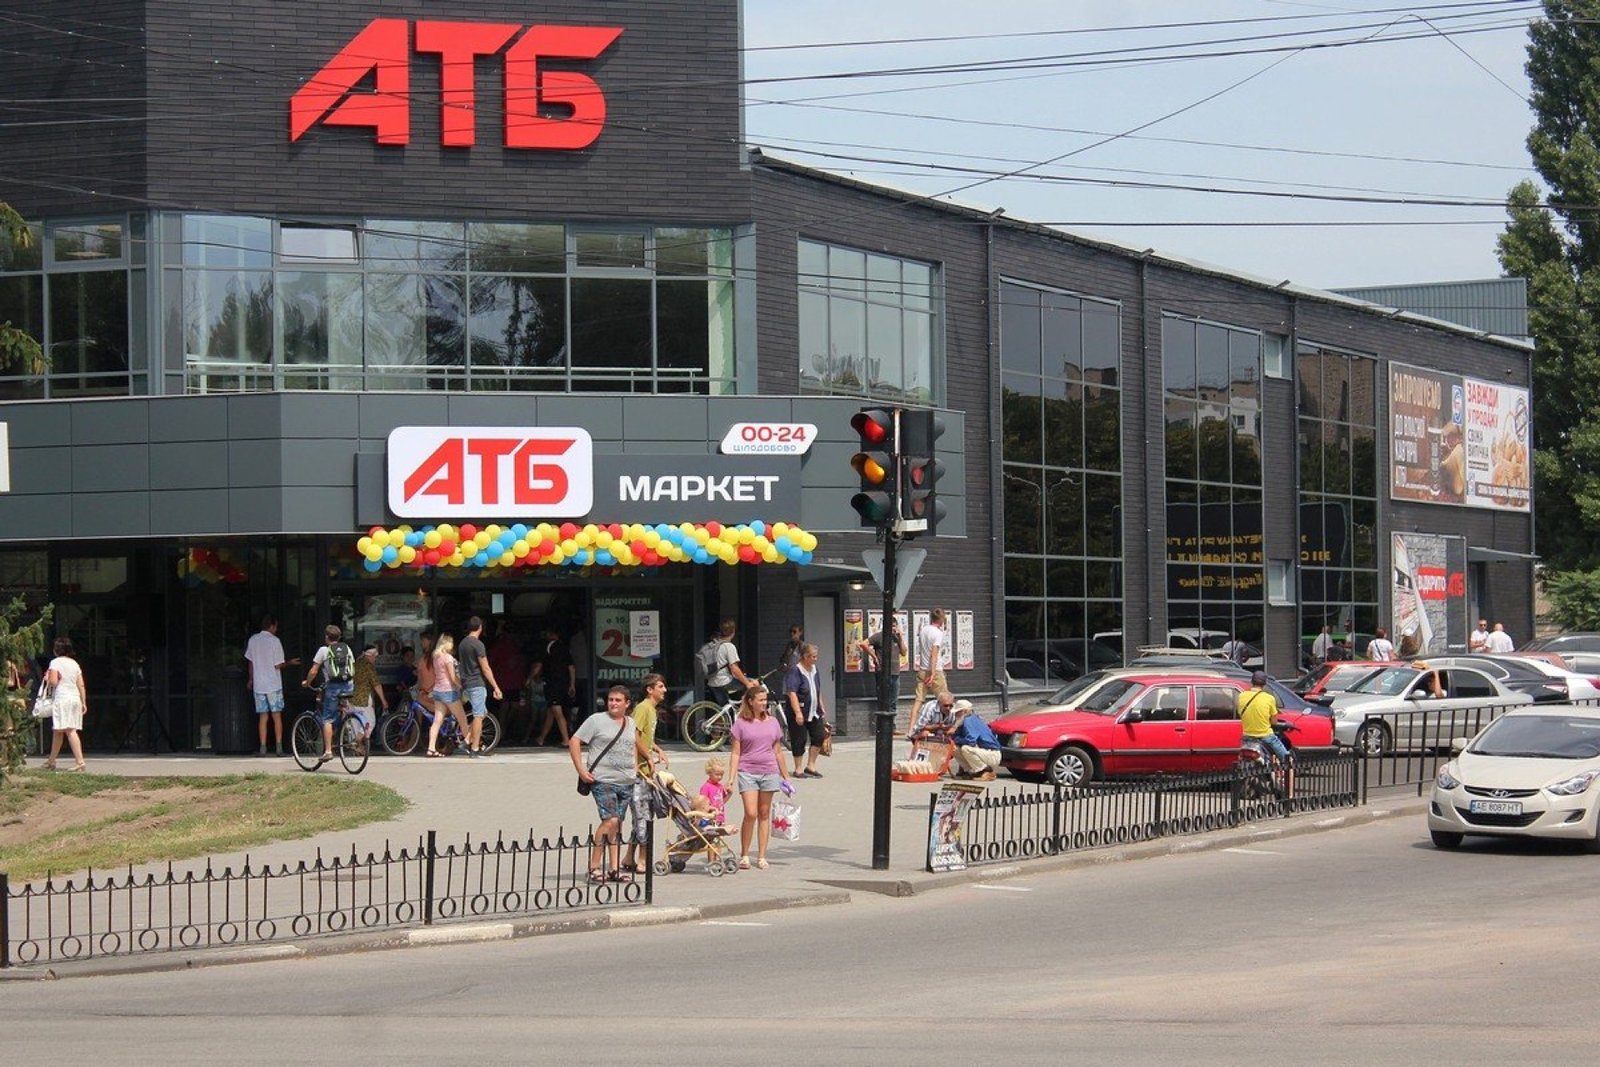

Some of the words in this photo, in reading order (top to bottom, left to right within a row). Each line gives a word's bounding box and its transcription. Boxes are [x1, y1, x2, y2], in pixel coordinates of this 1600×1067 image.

[289, 18, 625, 149] АТБ
[1467, 382, 1499, 409] ЗАВЖДИ
[741, 426, 806, 442] 00-24
[733, 444, 797, 452] ЦІЛОДОБОВО
[404, 438, 576, 504] АТБ
[619, 475, 779, 501] МАРКЕТ
[597, 668, 650, 680] ЛИПНЯ
[1507, 804, 1519, 812] HT
